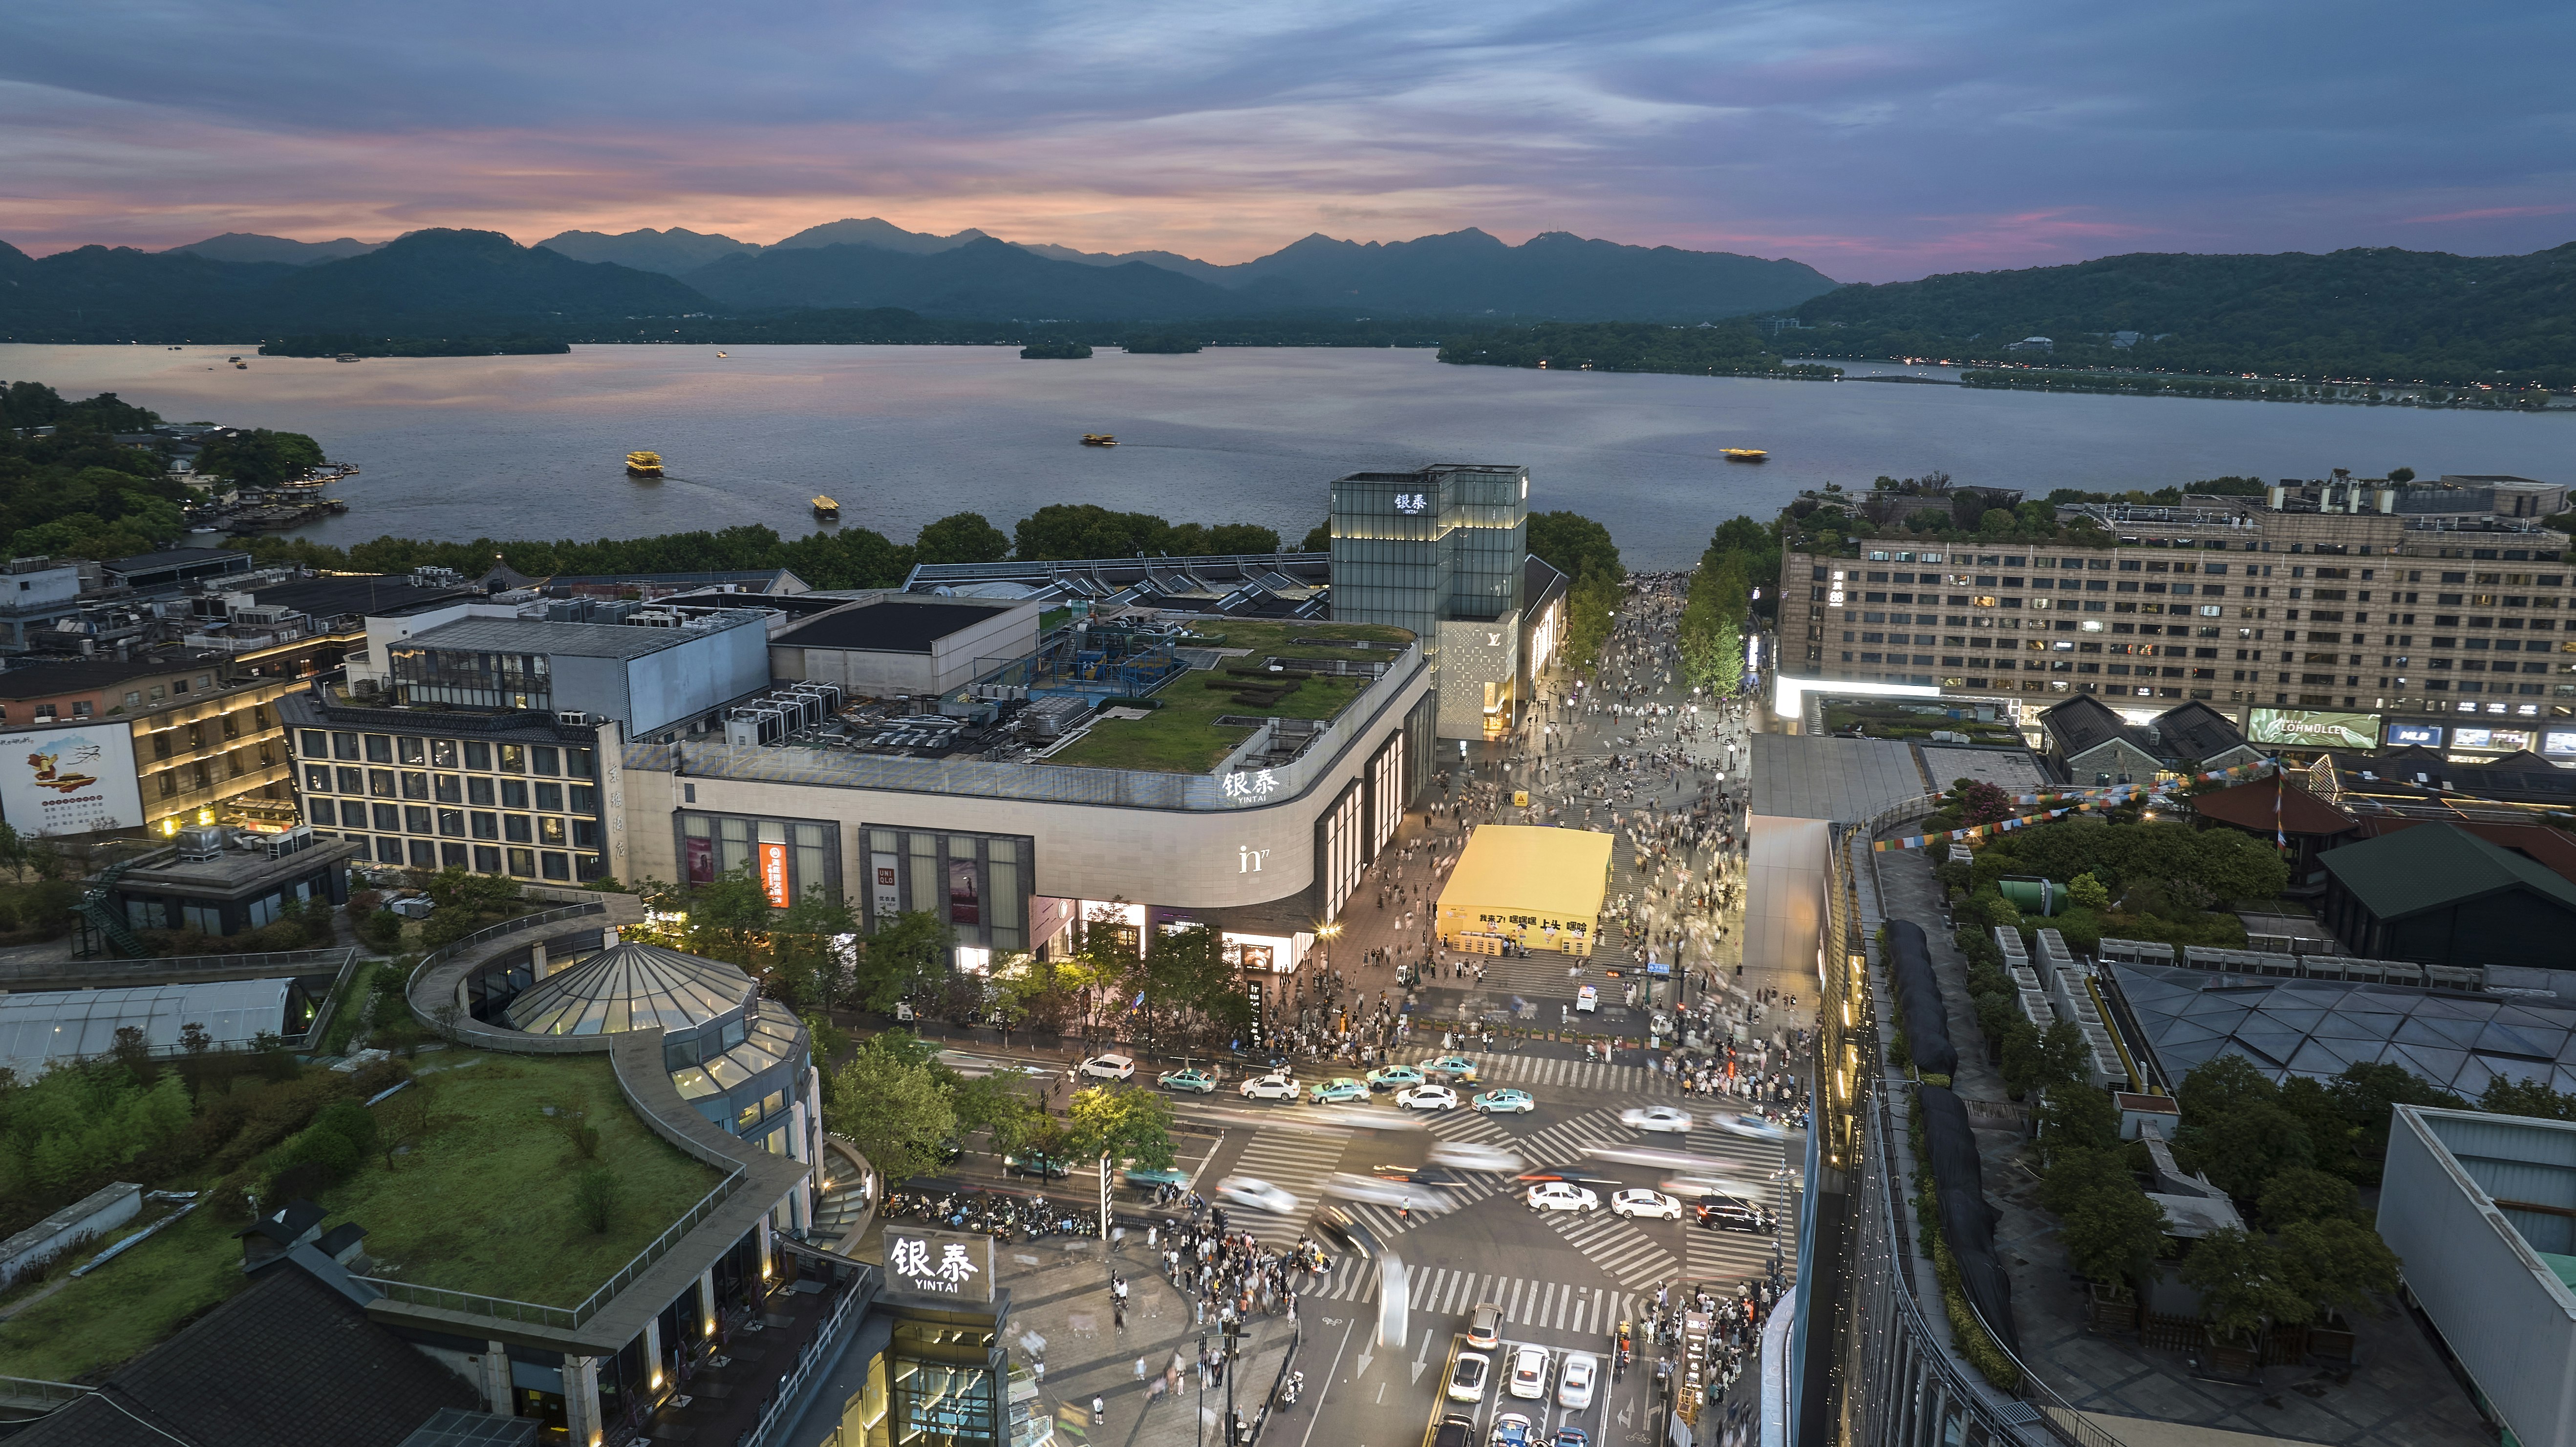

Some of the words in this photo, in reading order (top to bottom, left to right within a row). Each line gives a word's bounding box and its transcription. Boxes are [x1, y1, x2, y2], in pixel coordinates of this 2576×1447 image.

[1395, 494, 1427, 510] 银泰
[2281, 724, 2348, 734] LOHMÜLLER
[2399, 731, 2430, 741] MLB
[1222, 768, 1280, 797] 银泰
[1238, 795, 1266, 804] YINTAI
[1540, 919, 1561, 931] 上头
[890, 1237, 979, 1282] 银泰
[915, 1278, 958, 1293] YINTAI
